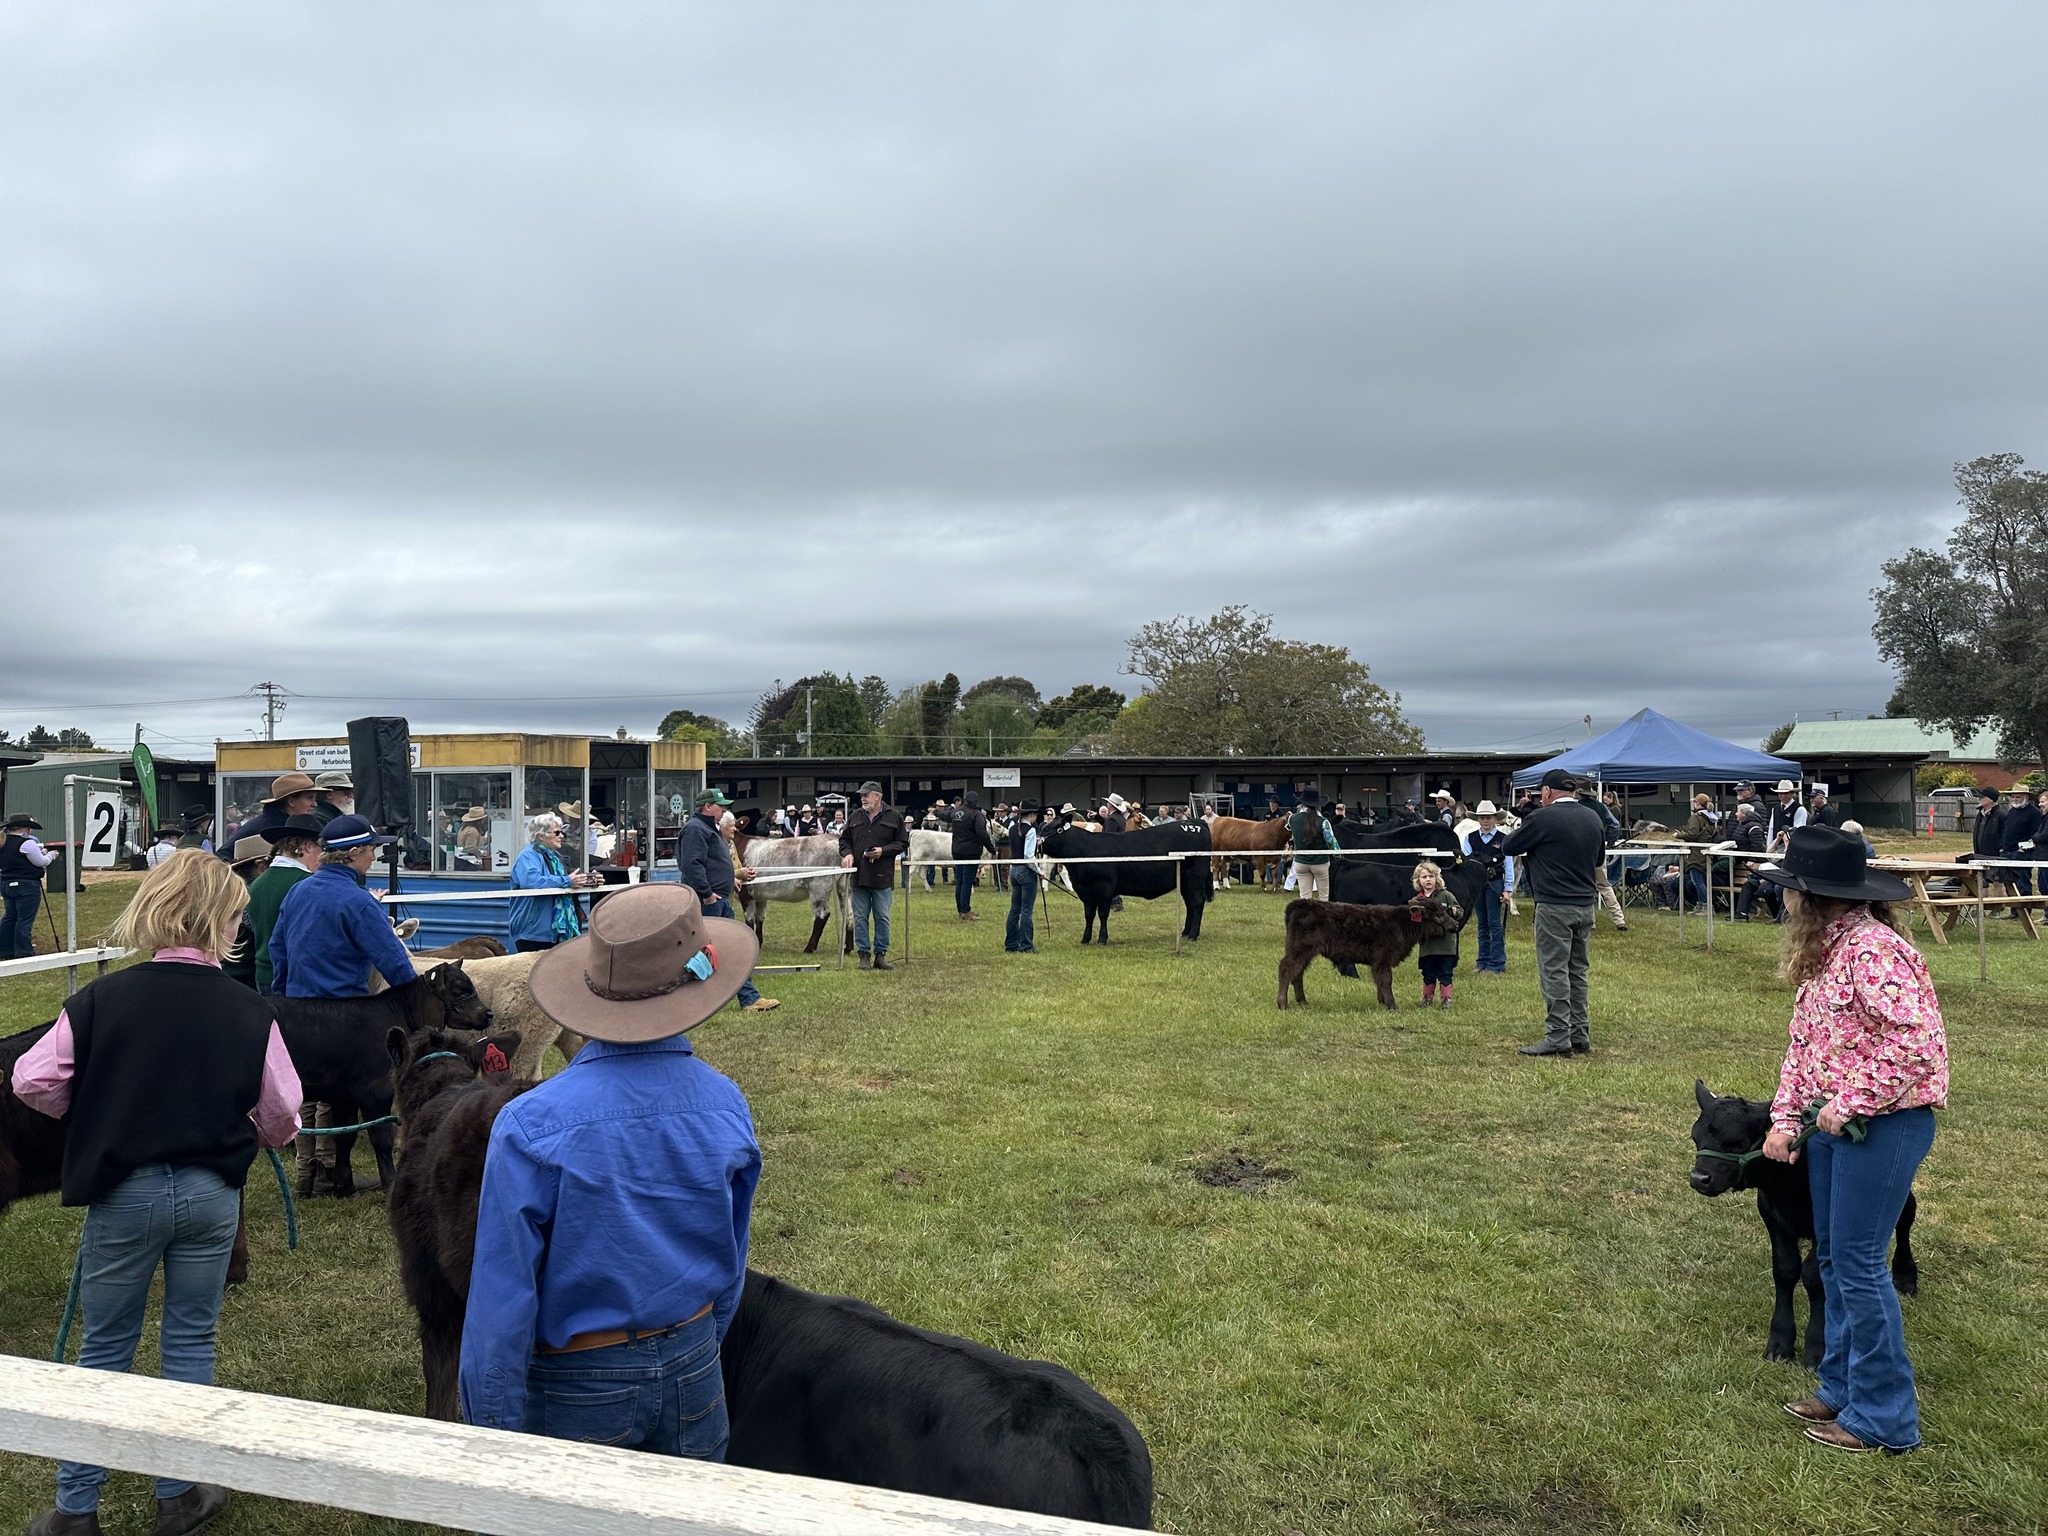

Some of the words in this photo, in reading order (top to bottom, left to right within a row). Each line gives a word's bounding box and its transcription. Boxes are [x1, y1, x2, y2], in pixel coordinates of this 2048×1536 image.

[89, 801, 115, 853] 2
[1180, 824, 1201, 833] V57
[483, 1054, 504, 1071] M3
